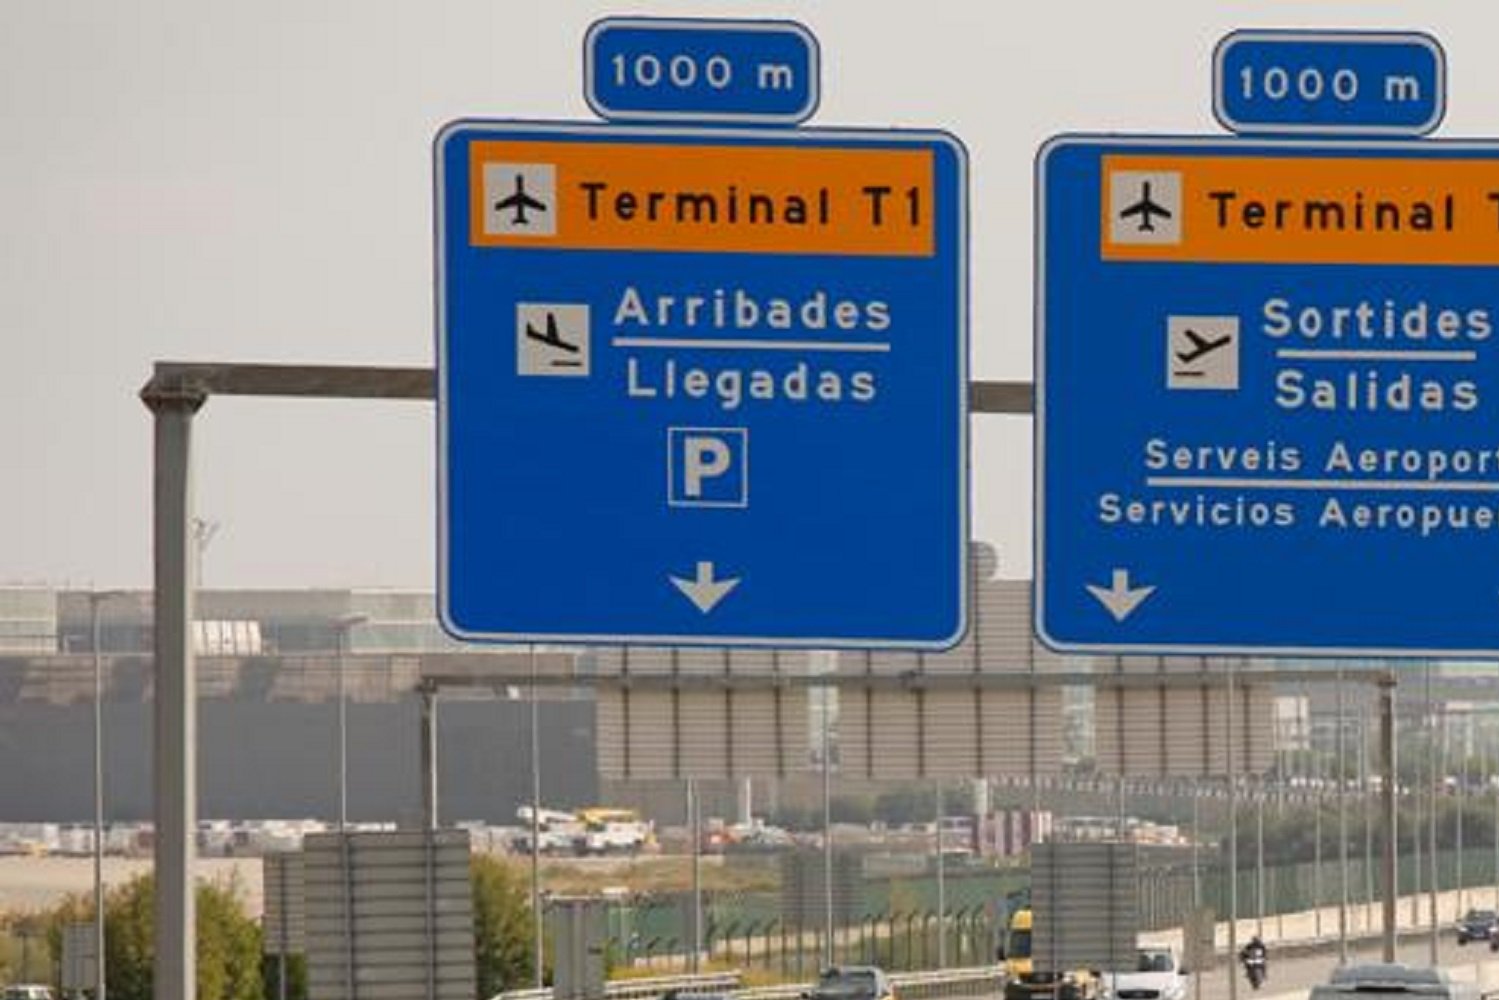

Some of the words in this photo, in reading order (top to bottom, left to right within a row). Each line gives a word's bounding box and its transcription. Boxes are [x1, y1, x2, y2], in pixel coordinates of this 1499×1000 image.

[613, 54, 732, 89] 1000
[758, 63, 793, 89] m
[1241, 67, 1359, 102] 1000
[1385, 76, 1420, 101] m
[579, 181, 829, 226] Terminal
[862, 185, 920, 227] T1
[1208, 190, 1454, 232] Terminal
[614, 287, 891, 331] Arribades
[1263, 298, 1492, 340] Sortides
[627, 358, 875, 410] Llegadas
[1275, 369, 1478, 411] Salidas
[683, 436, 731, 497] P
[1145, 438, 1301, 472] Serveis
[1099, 493, 1294, 526] Servicios
